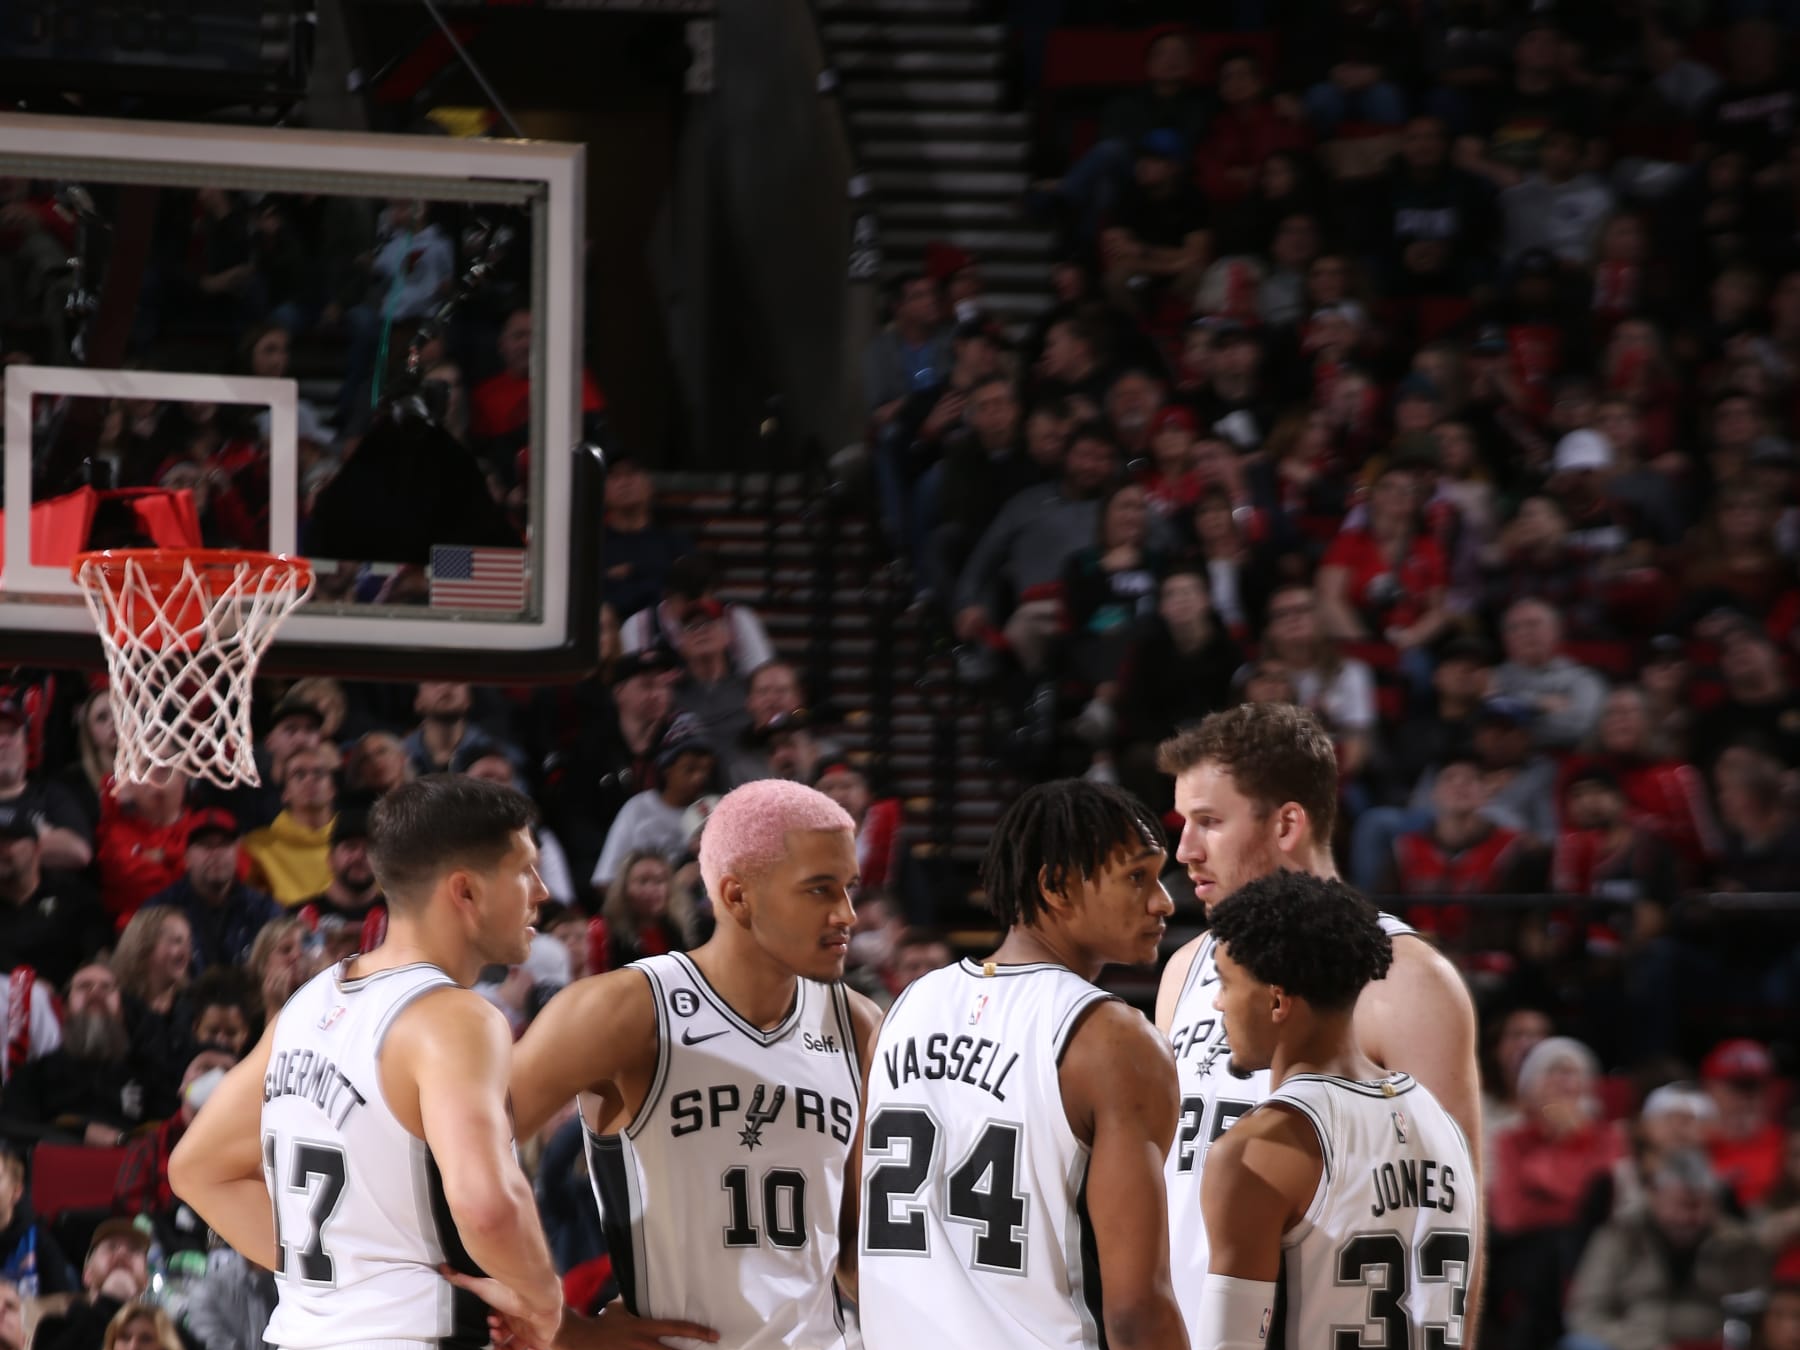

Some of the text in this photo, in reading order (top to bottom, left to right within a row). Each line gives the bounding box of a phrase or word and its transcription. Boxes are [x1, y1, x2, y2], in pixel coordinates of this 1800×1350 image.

[675, 992, 694, 1014] 6
[803, 1032, 840, 1053] Self.
[883, 1032, 1020, 1102] VASSELL
[671, 1084, 853, 1150] SPURS
[262, 1128, 348, 1289] 17
[721, 1164, 809, 1251] 10
[861, 1103, 1031, 1278] 24
[1371, 1159, 1456, 1217] JONES
